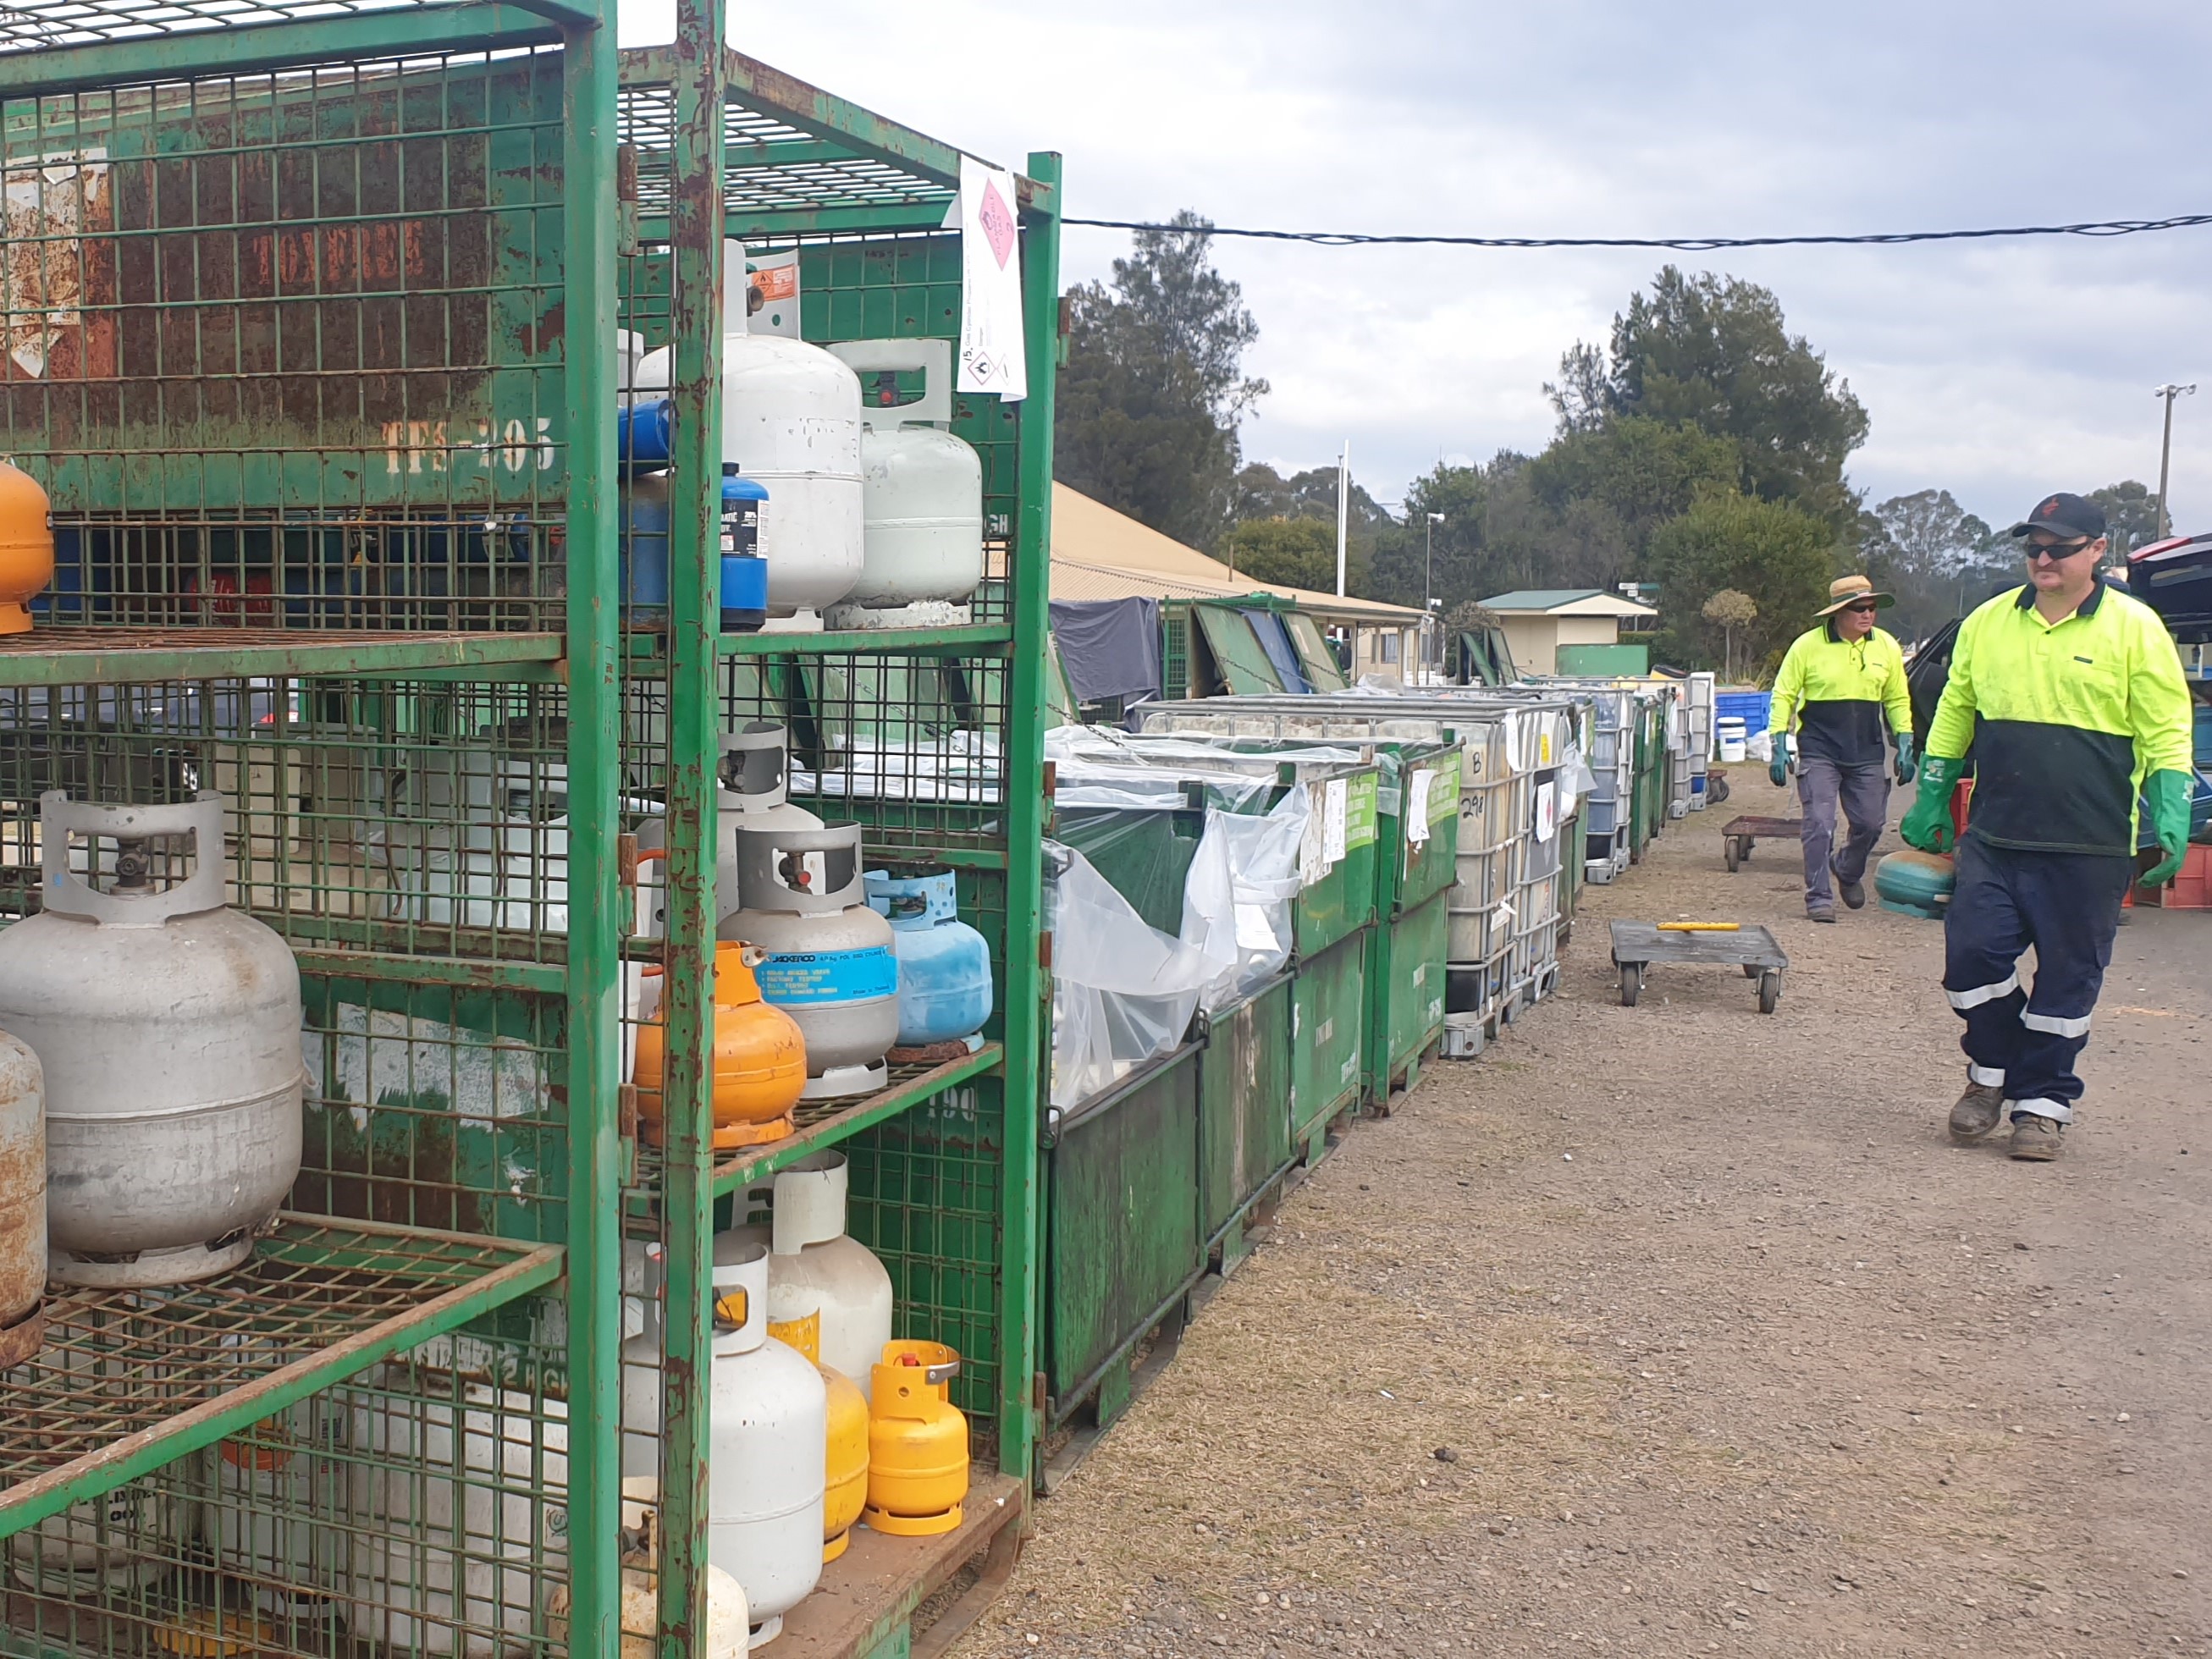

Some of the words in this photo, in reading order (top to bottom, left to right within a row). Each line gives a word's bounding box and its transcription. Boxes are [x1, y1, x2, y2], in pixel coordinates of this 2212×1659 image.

[1473, 752, 1481, 774] B
[1461, 796, 1484, 818] 298
[772, 955, 815, 963] JACKEROO
